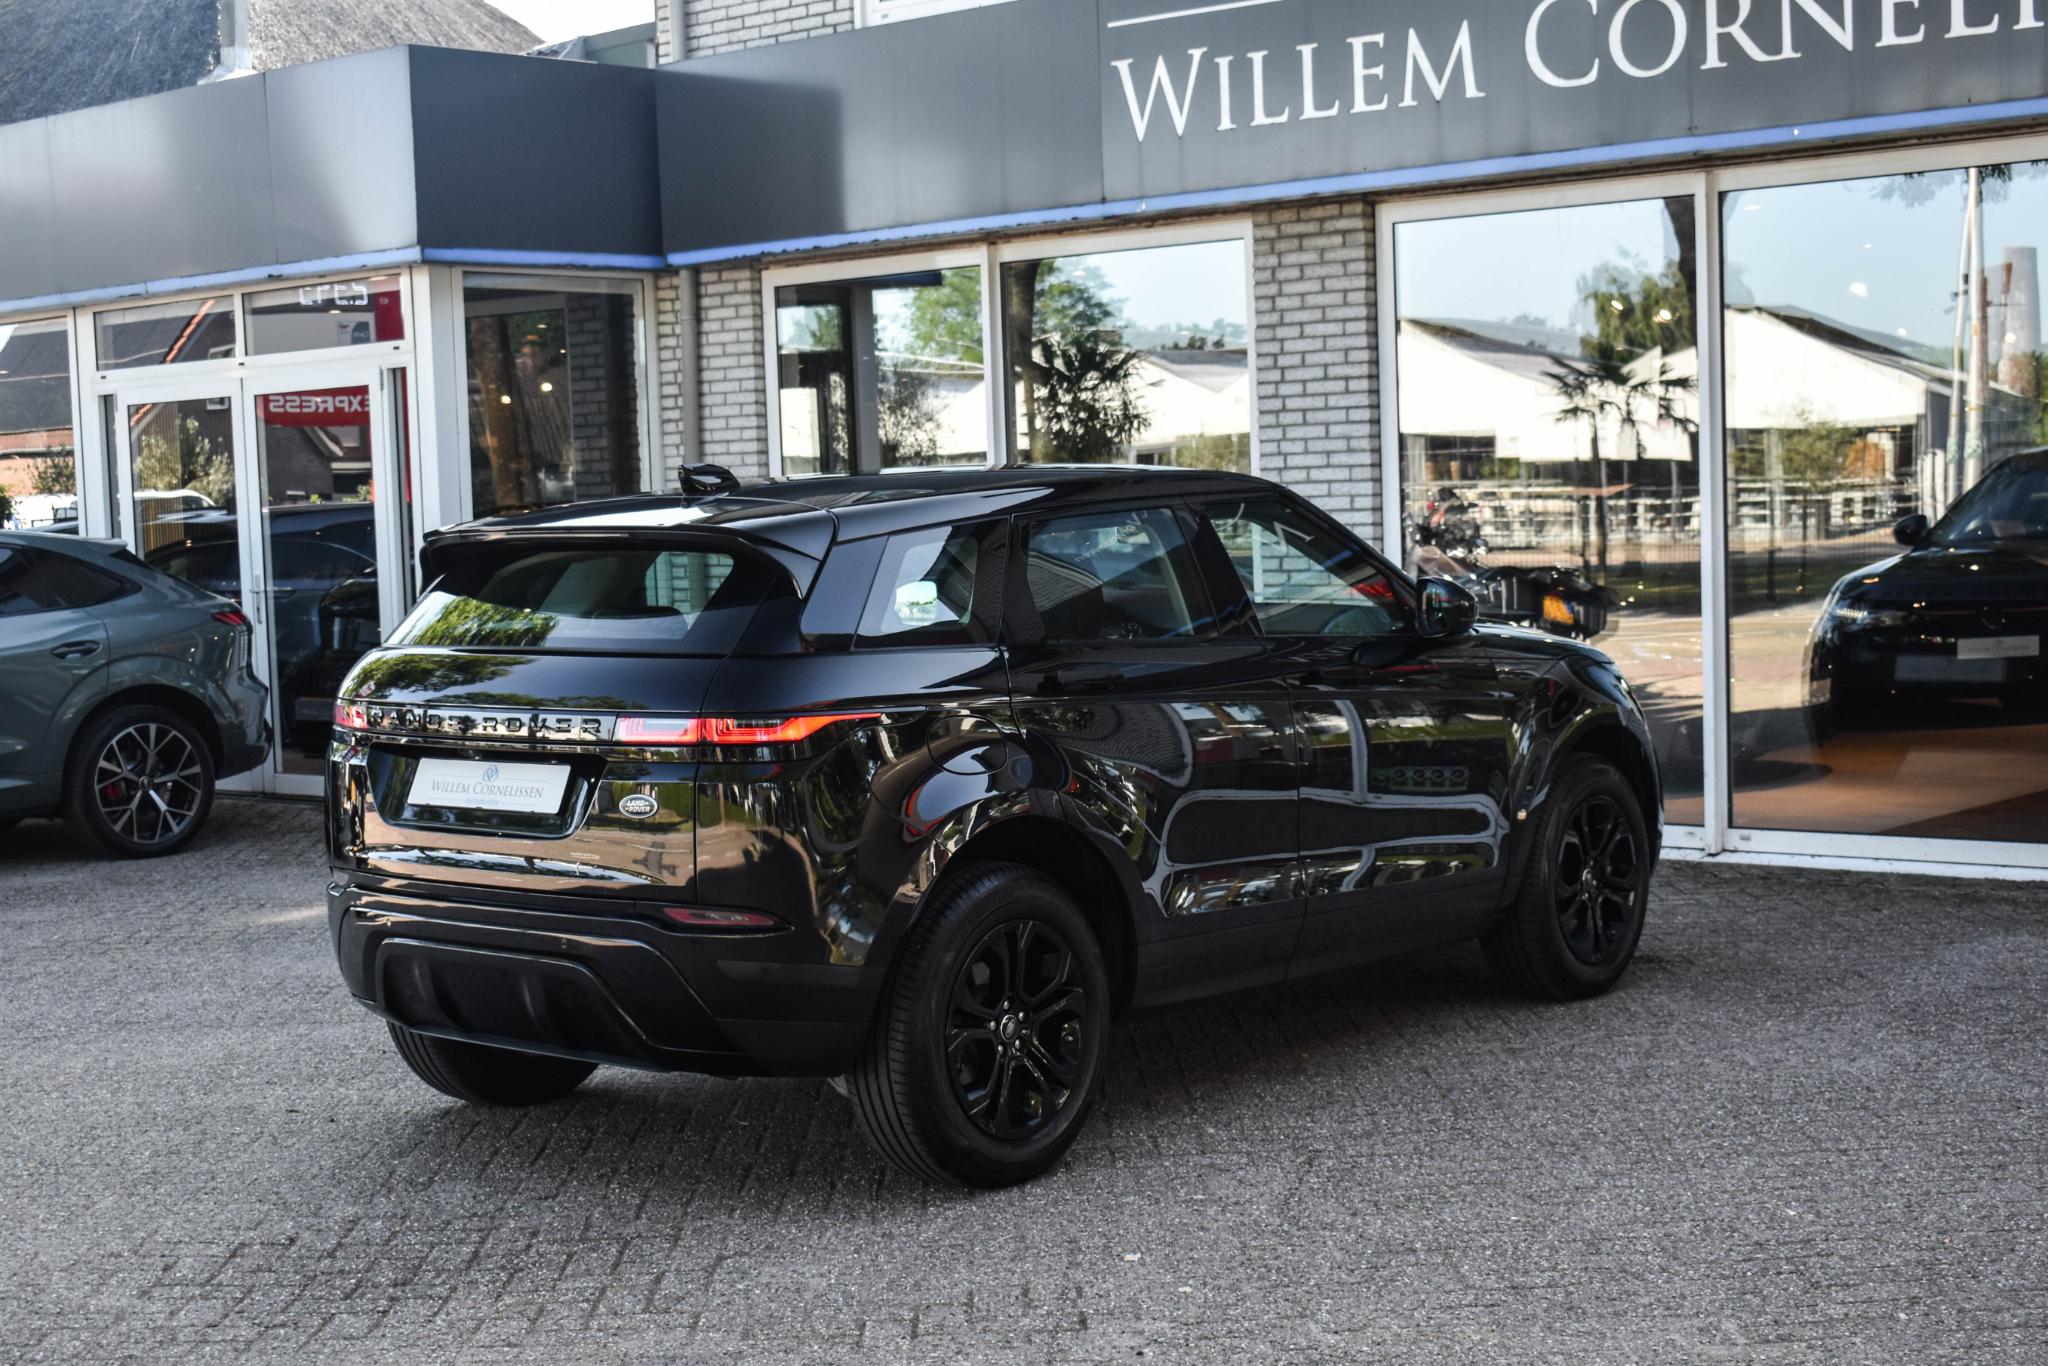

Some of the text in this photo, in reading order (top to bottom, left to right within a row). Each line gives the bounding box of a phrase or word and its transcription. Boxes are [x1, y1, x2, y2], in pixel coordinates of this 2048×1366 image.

[1109, 20, 1486, 142] WILLEM
[482, 715, 602, 734] ROVER
[431, 779, 544, 799] WILLEM CORNELISSEN
